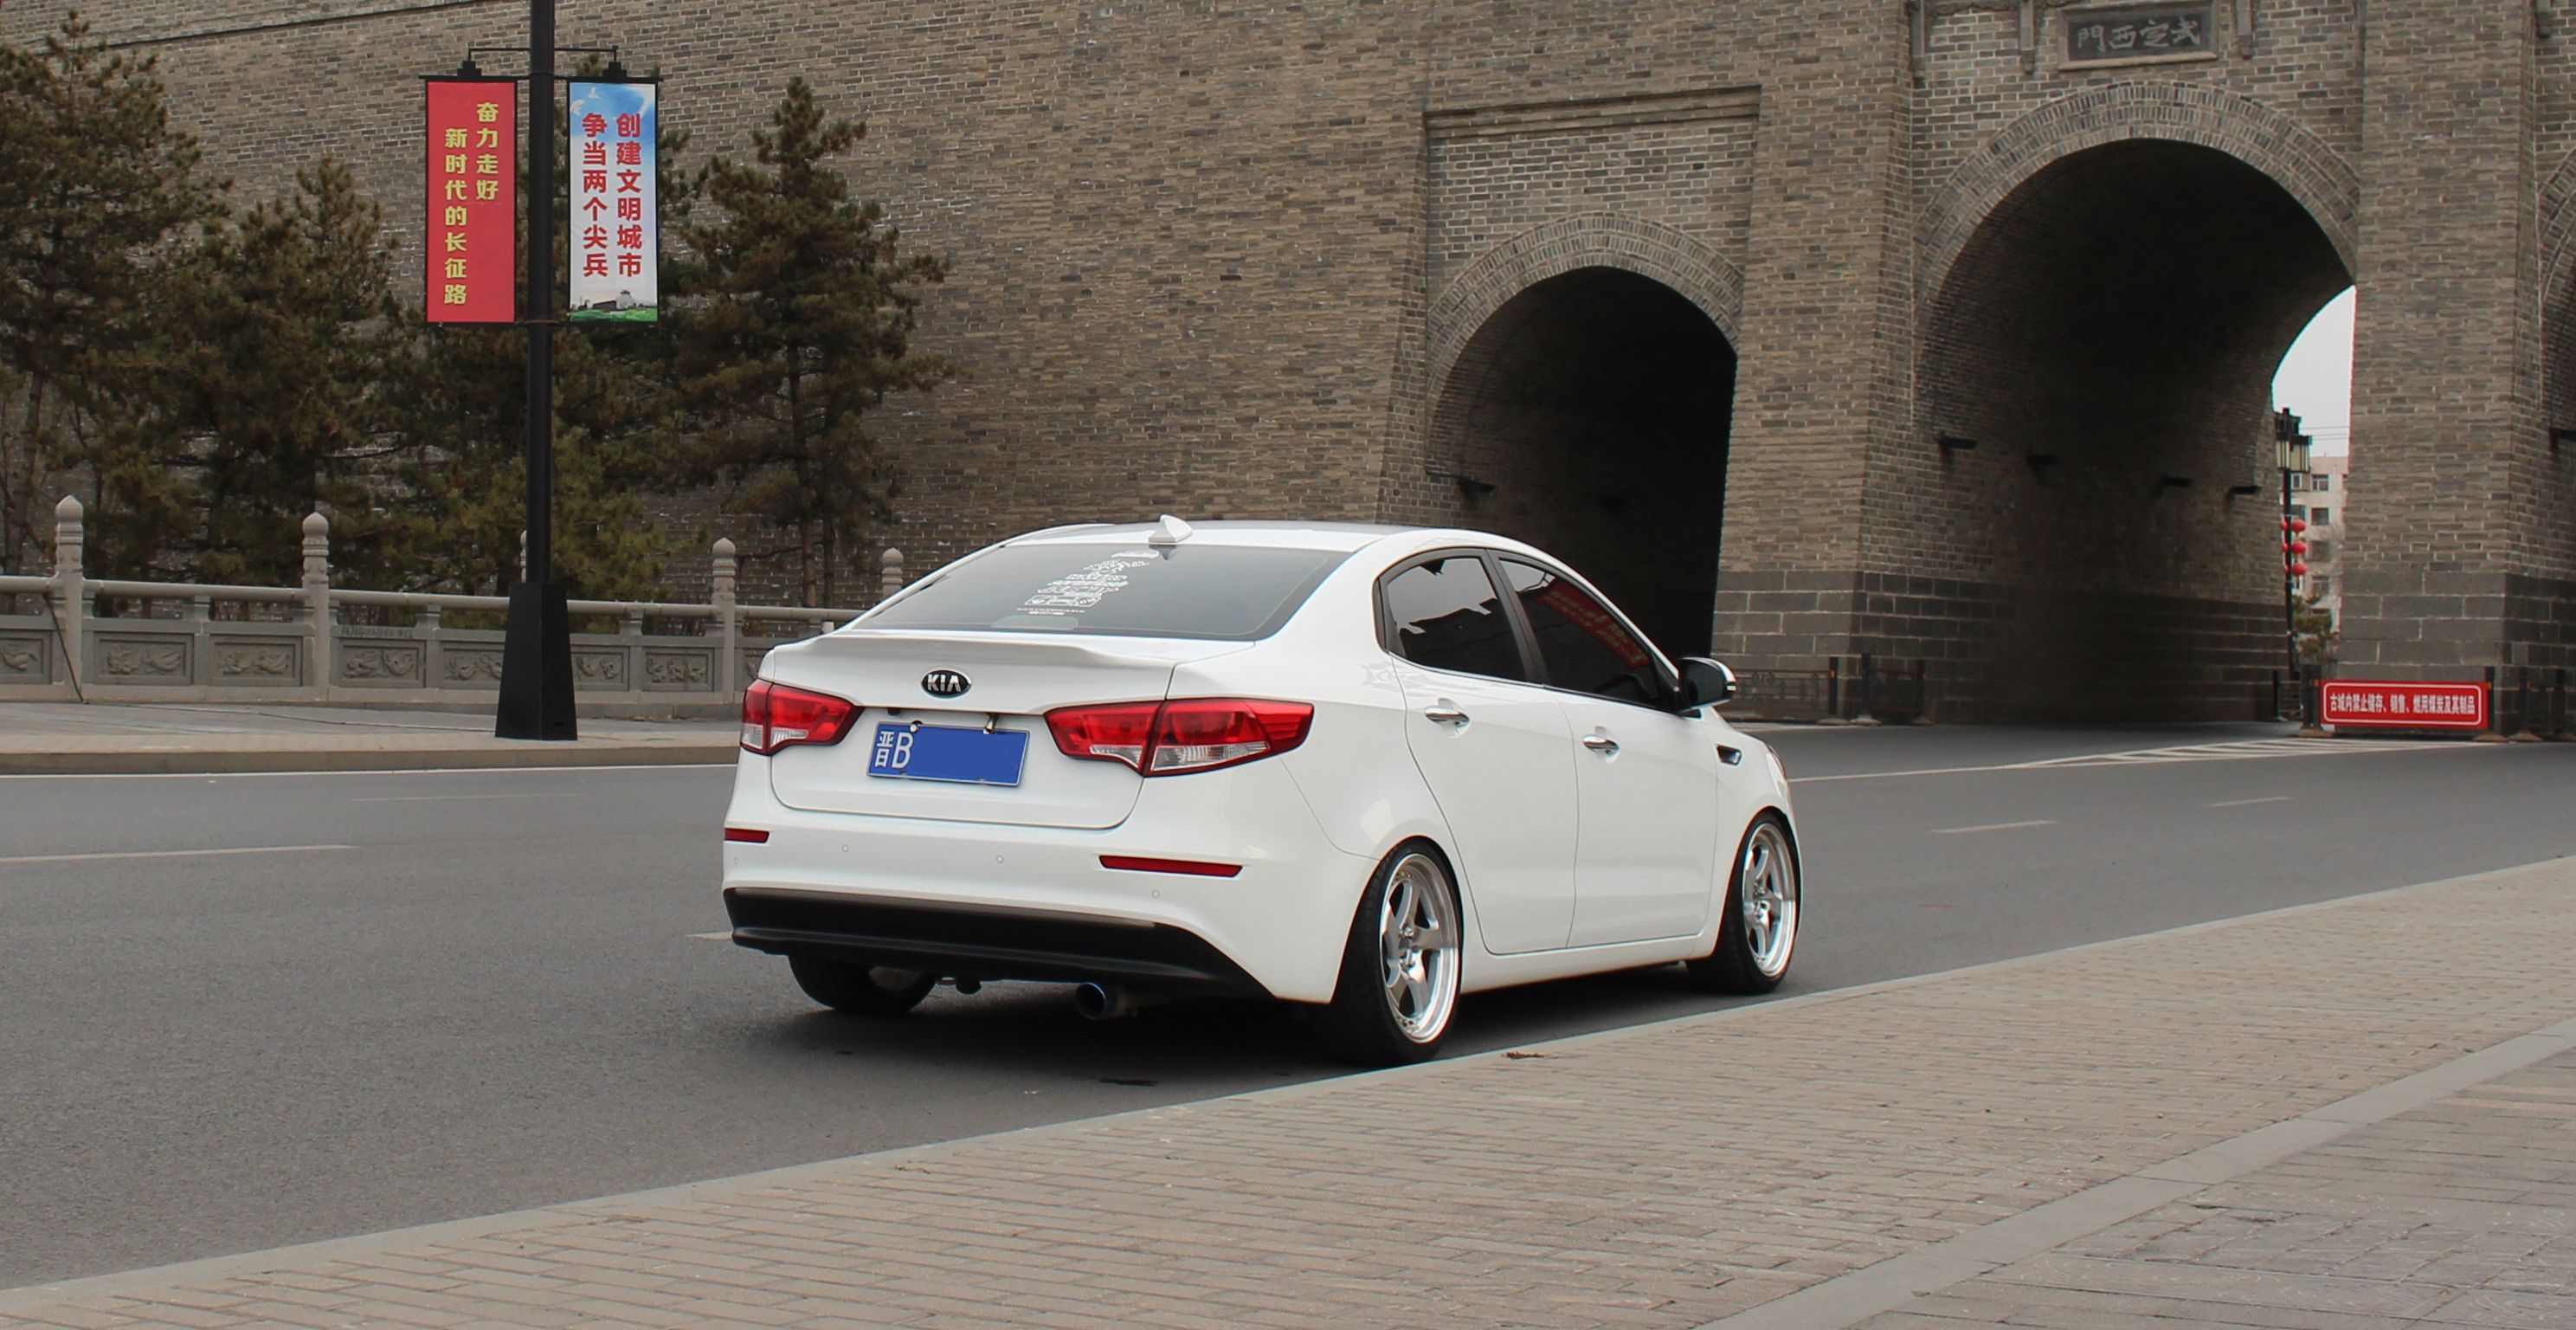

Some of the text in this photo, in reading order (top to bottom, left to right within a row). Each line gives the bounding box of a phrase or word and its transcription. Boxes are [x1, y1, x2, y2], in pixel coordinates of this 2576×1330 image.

[444, 128, 467, 305] 新时代的长征路
[476, 102, 499, 201] 奋力走好
[582, 113, 609, 278] 争当两个尖兵
[615, 113, 642, 278] 创建文明城市
[874, 730, 914, 769] 晋B
[927, 674, 962, 693] KIA
